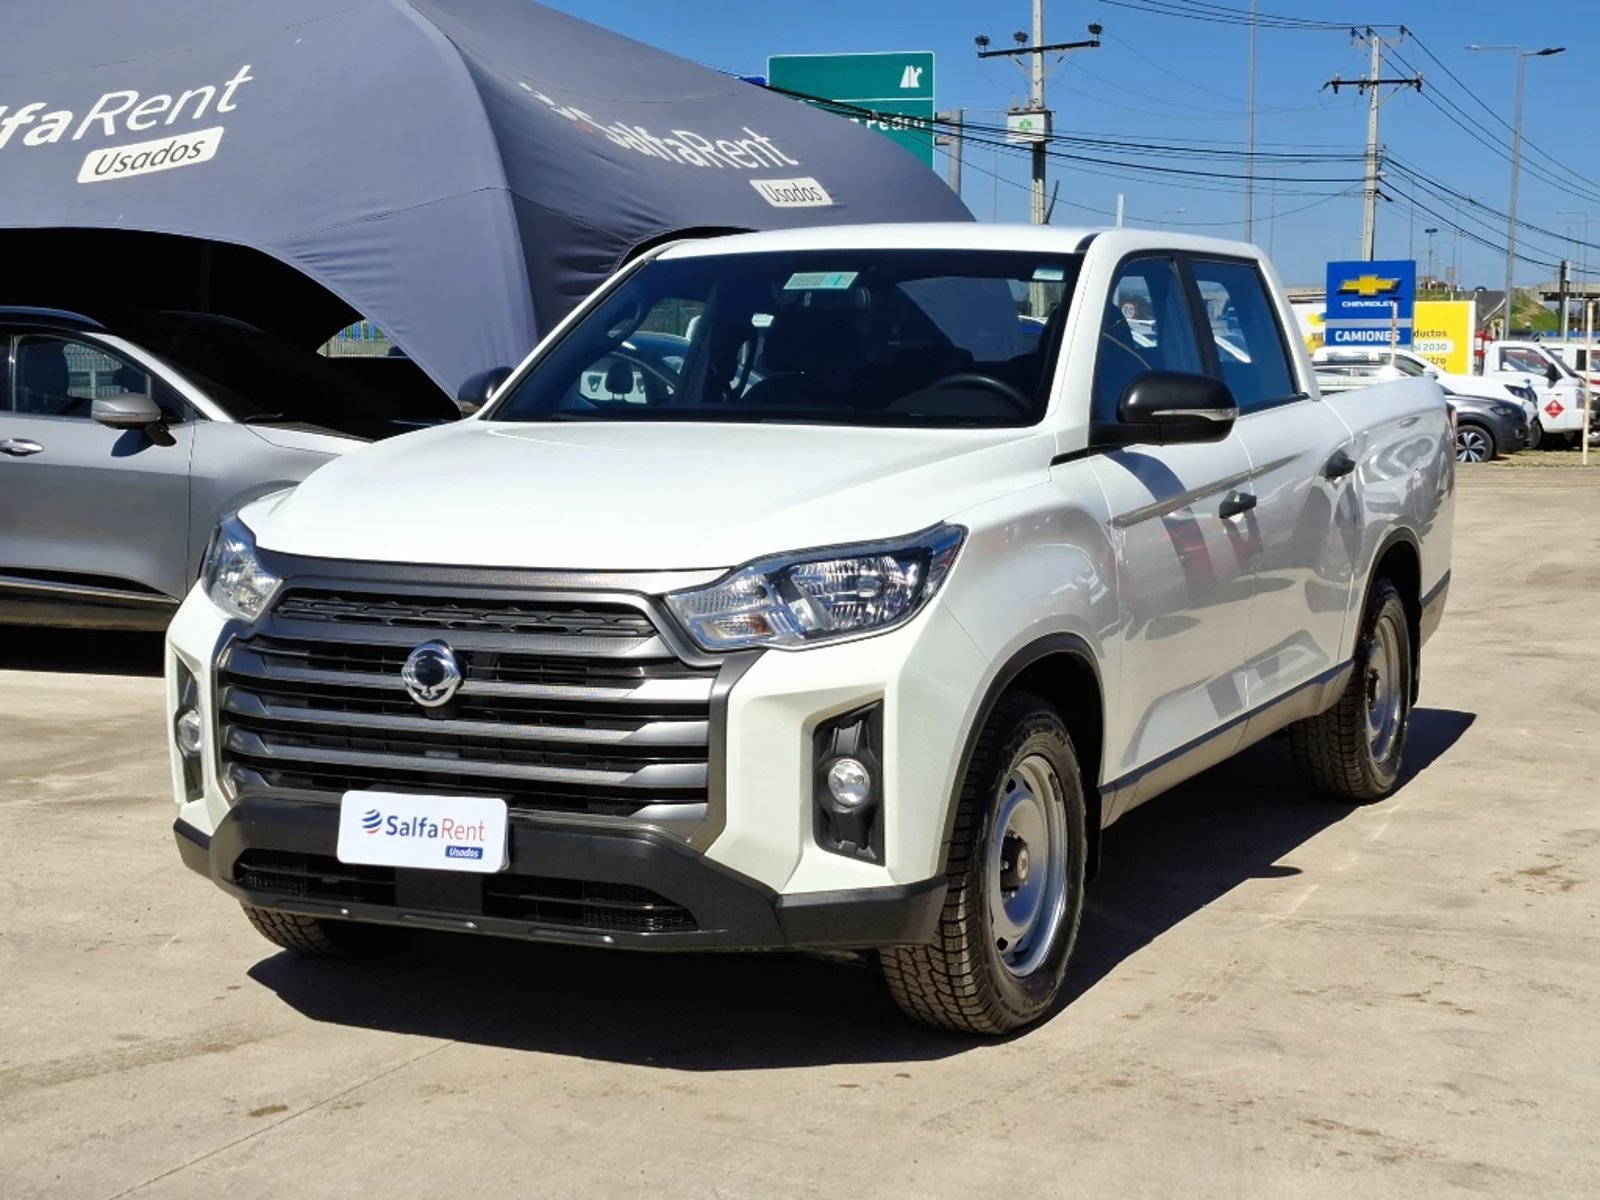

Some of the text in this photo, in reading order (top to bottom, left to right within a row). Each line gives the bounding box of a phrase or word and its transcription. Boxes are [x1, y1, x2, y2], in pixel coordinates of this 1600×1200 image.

[0, 64, 253, 149] faRent
[94, 140, 205, 176] Usados
[761, 182, 822, 203] Usados
[1341, 300, 1393, 308] CHEVROLET
[1335, 330, 1400, 342] CAMIONES
[385, 815, 485, 842] SalfaRent
[450, 847, 480, 859] Usados
